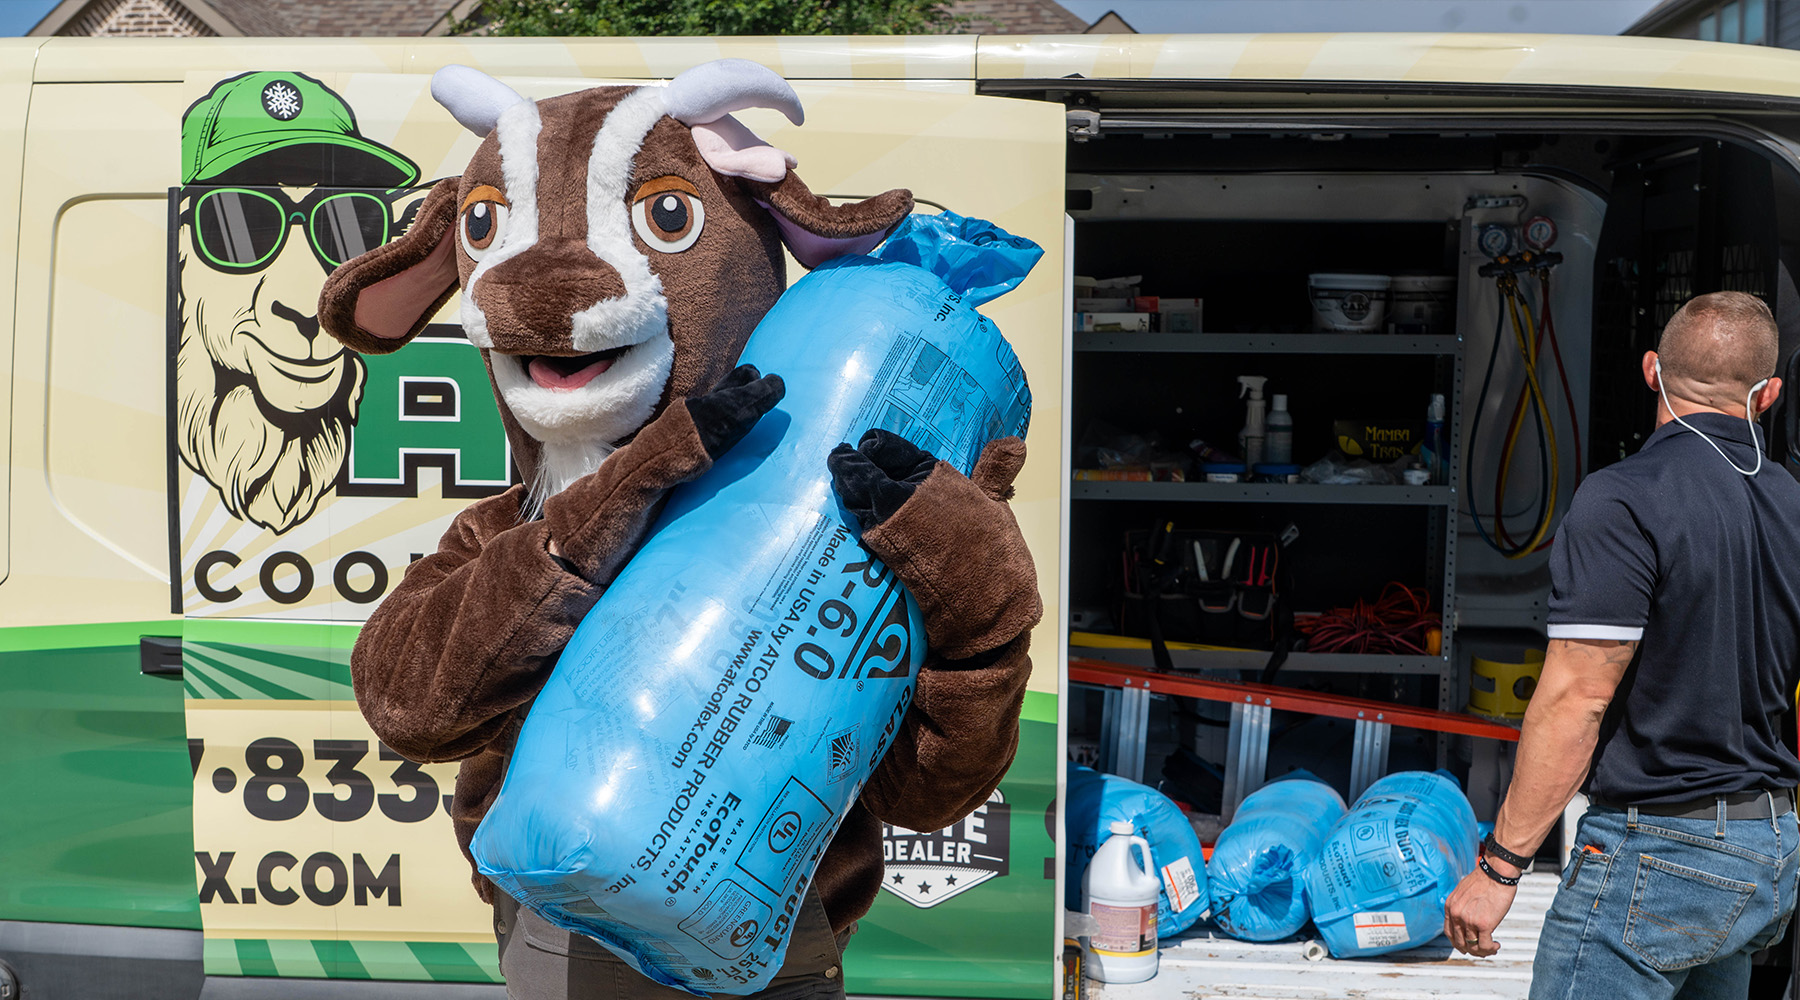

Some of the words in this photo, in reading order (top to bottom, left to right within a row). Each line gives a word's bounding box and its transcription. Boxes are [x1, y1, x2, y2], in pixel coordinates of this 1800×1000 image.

[932, 302, 957, 324] Inc.
[1365, 426, 1410, 441] MAMBA
[814, 523, 851, 574] Made
[194, 551, 422, 604] COO
[805, 568, 827, 591] in
[782, 586, 817, 628] USA
[791, 539, 889, 684] R-6.0
[767, 621, 794, 648] by
[743, 643, 781, 693] ATCO
[669, 627, 764, 771] www.atcoflex.com
[695, 692, 752, 771] RUBBER
[866, 683, 912, 771] CLASS
[630, 768, 706, 869] PRODUCTS,
[659, 792, 717, 880] INSULATION
[718, 816, 744, 855] MADE
[772, 820, 797, 838] UL
[884, 840, 972, 864] DEALER
[1394, 830, 1416, 864] DUCT
[604, 873, 637, 894] Inc.
[691, 861, 718, 895] WITH
[707, 900, 752, 944] GREENGUARD
[737, 951, 759, 969] 25
